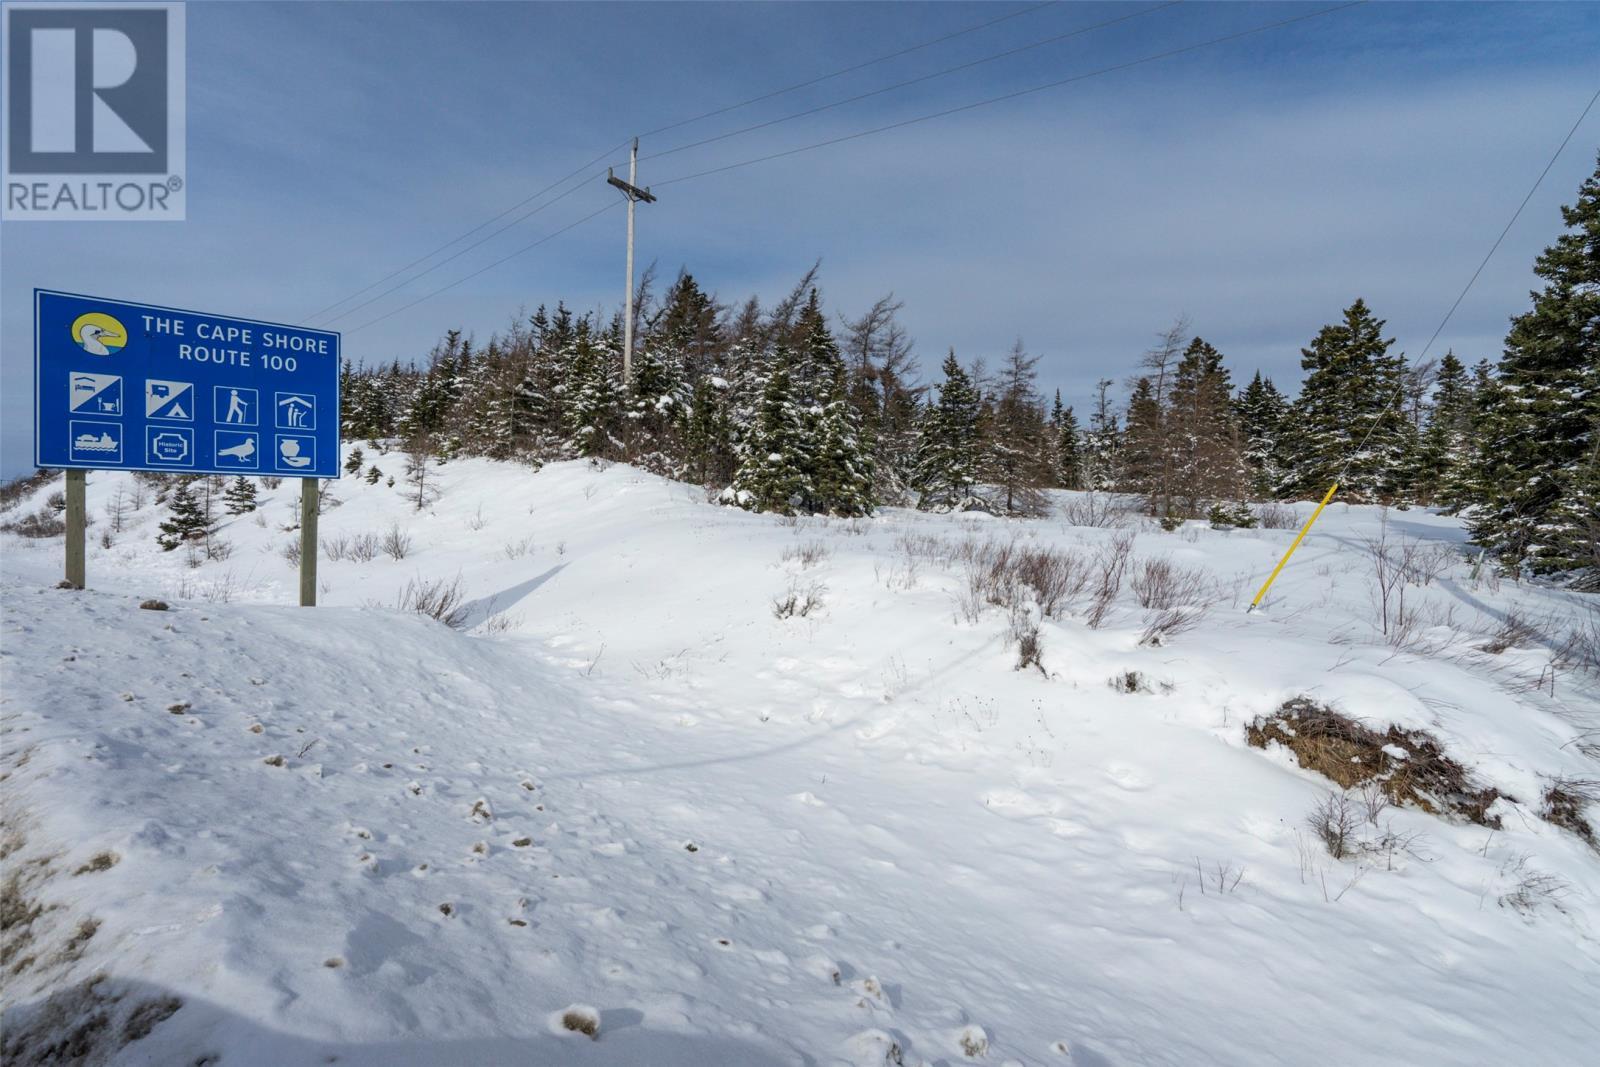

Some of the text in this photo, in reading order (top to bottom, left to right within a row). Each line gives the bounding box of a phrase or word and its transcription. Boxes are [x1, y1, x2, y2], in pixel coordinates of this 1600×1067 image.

[141, 315, 329, 355] THE CAPE SHORE
[179, 344, 298, 373] ROUTE 100
[158, 441, 184, 449] Historic
